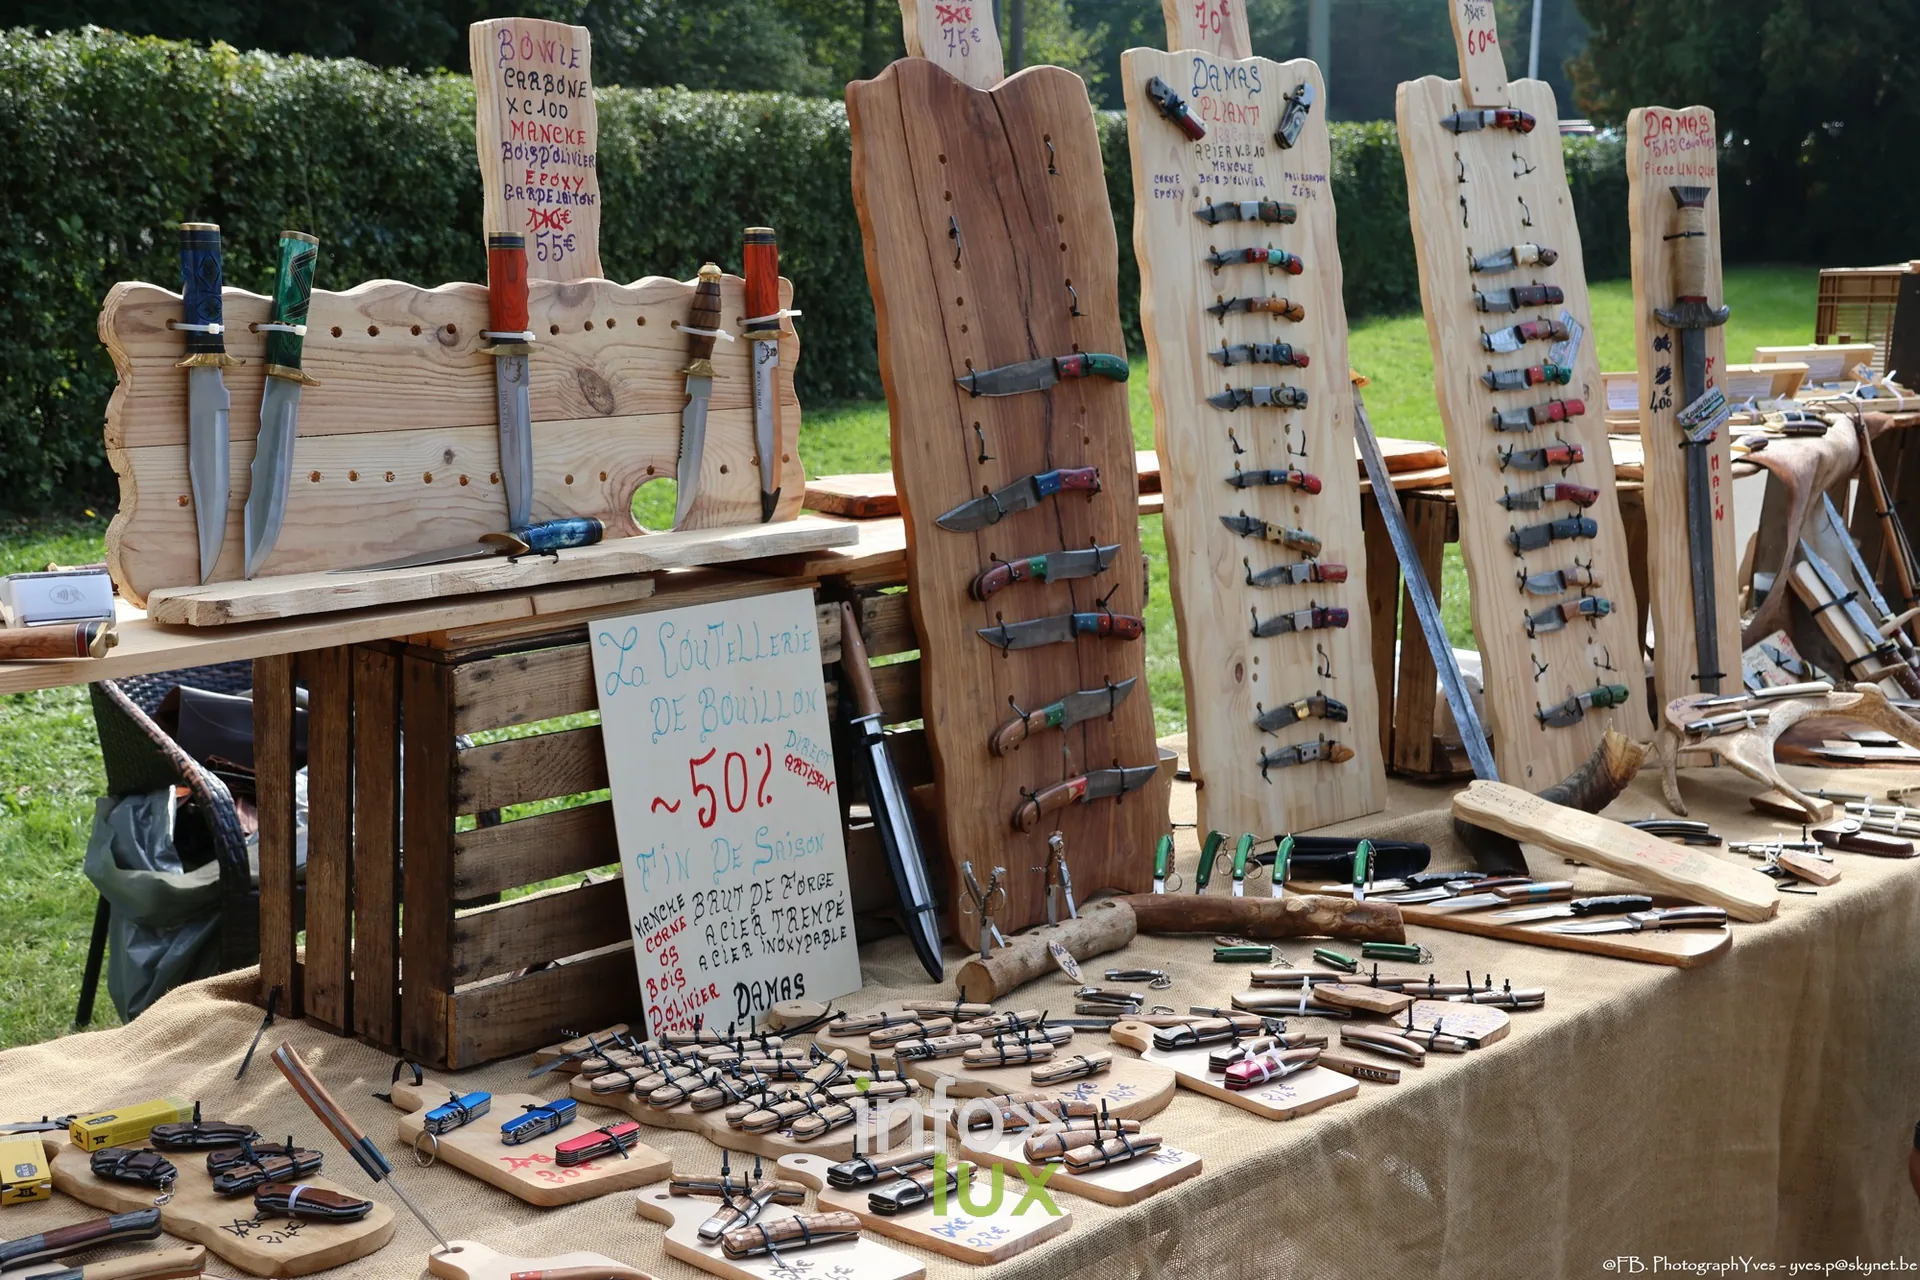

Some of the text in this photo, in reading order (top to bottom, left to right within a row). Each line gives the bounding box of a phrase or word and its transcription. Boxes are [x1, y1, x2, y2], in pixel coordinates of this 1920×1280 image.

[943, 27, 981, 58] 75€
[1468, 28, 1496, 56] 60€
[504, 67, 587, 98] CARBONE
[1192, 58, 1261, 99] DAMAS
[510, 121, 586, 145] MANCHE
[1644, 111, 1710, 147] DAMAS
[1212, 161, 1254, 174] MANCHE
[536, 230, 576, 262] 55€
[650, 693, 687, 745] DE
[711, 837, 742, 885] DE
[634, 893, 686, 939] MANCHE
[692, 884, 743, 926] BRUT
[750, 877, 775, 915] DE
[645, 915, 687, 953] CORNE
[660, 945, 679, 967] OS
[733, 973, 805, 1026] DAMAS
